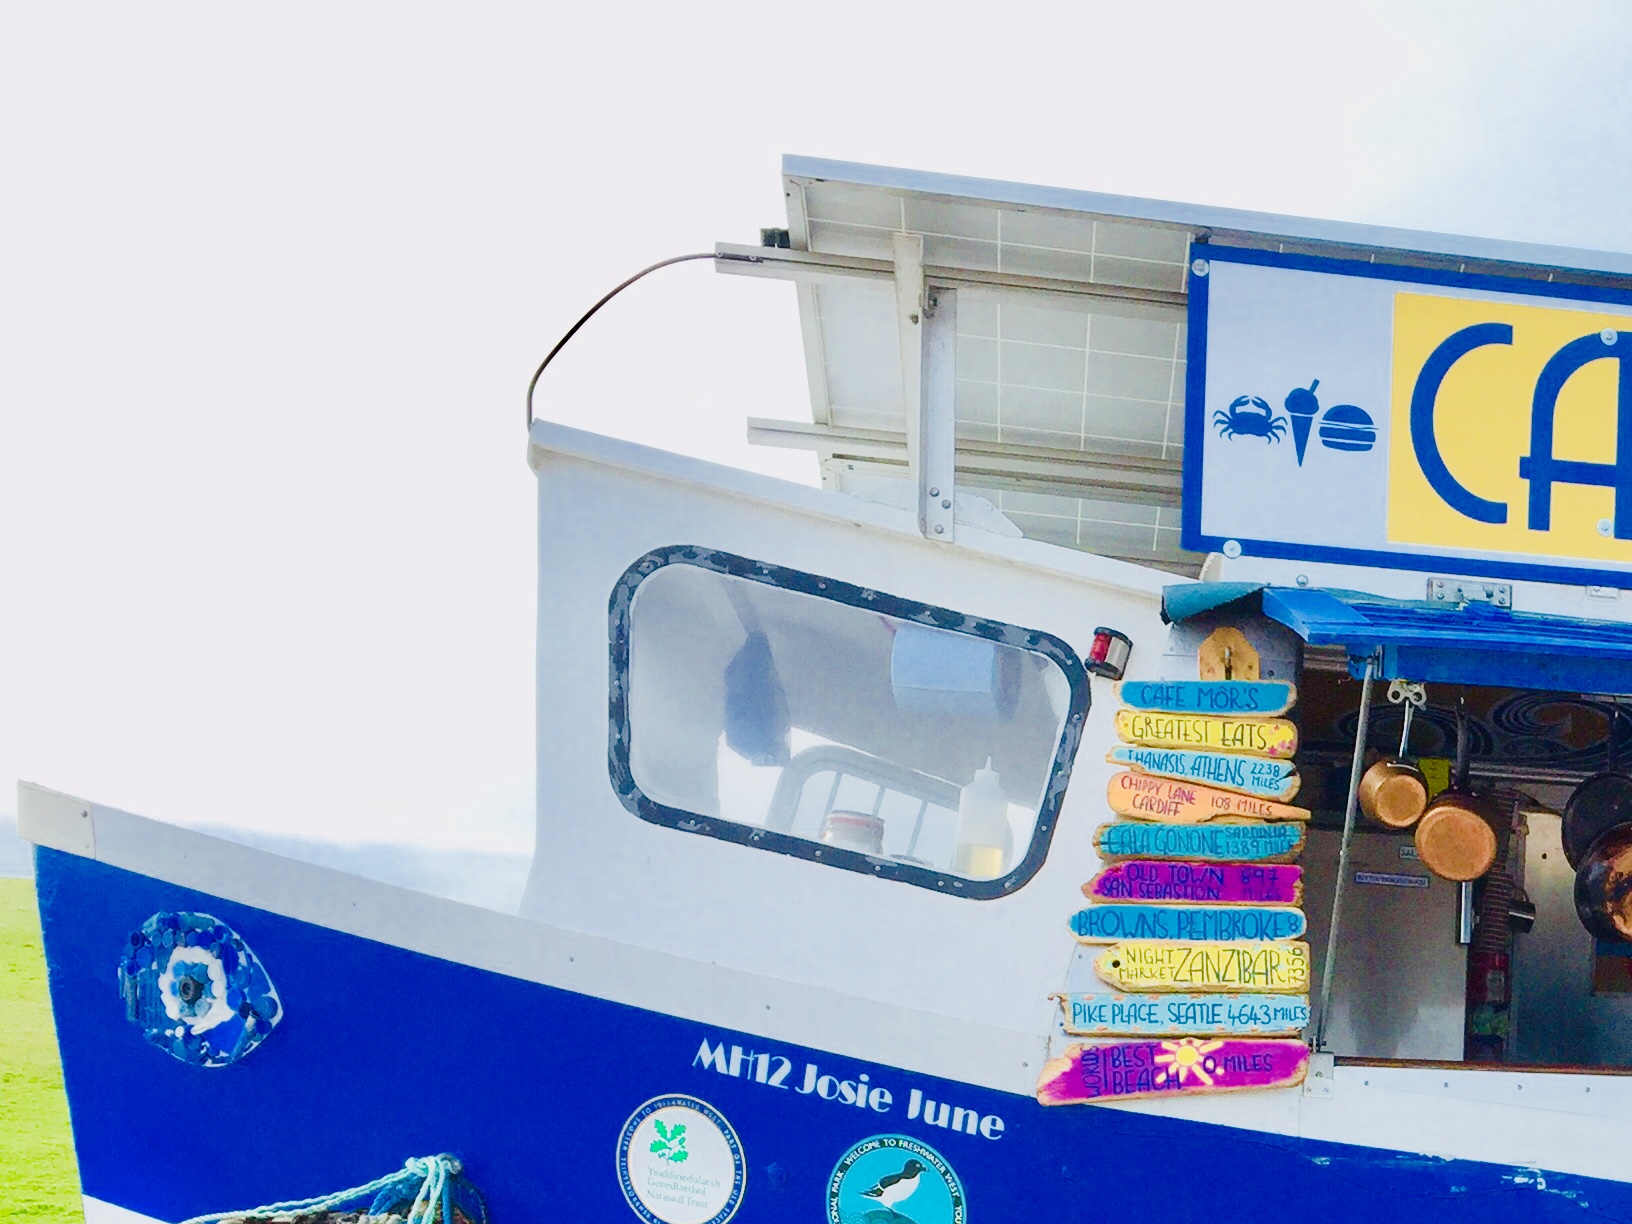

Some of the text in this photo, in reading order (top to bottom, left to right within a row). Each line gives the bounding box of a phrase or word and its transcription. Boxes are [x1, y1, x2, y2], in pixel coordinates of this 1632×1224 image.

[1141, 685, 1259, 709] CAFE MÔR'S
[1132, 715, 1266, 750] GREATEST EATS
[1190, 755, 1246, 786] ATHENS
[1251, 762, 1280, 777] 2238
[1251, 775, 1280, 790] MILES
[1121, 775, 1272, 816] CHIPPY LANE 108 MILES
[1132, 795, 1184, 816] CARDIFF
[1155, 830, 1225, 857] GONONE
[1225, 827, 1287, 839] SARDINIA
[1102, 877, 1132, 899] SAN
[1126, 864, 1225, 884] OLD TOWN
[1178, 912, 1285, 941] PEMBROKE
[1119, 967, 1175, 979] MARKET
[1127, 948, 1286, 985] NIGHT ZANZIBAR
[1073, 1003, 1107, 1024] PIKE
[1112, 1004, 1164, 1025] PLACE,
[1228, 1005, 1271, 1025] 4643
[1273, 1005, 1307, 1020] MILES
[1112, 1045, 1156, 1067] BEST
[691, 1037, 1005, 1141] MH12 Josie June
[1113, 1055, 1273, 1094] BEACH MILES
[844, 1140, 880, 1166] WELCOME
[899, 1140, 947, 1174] FRESHWATER
[954, 1205, 962, 1224] YOU
